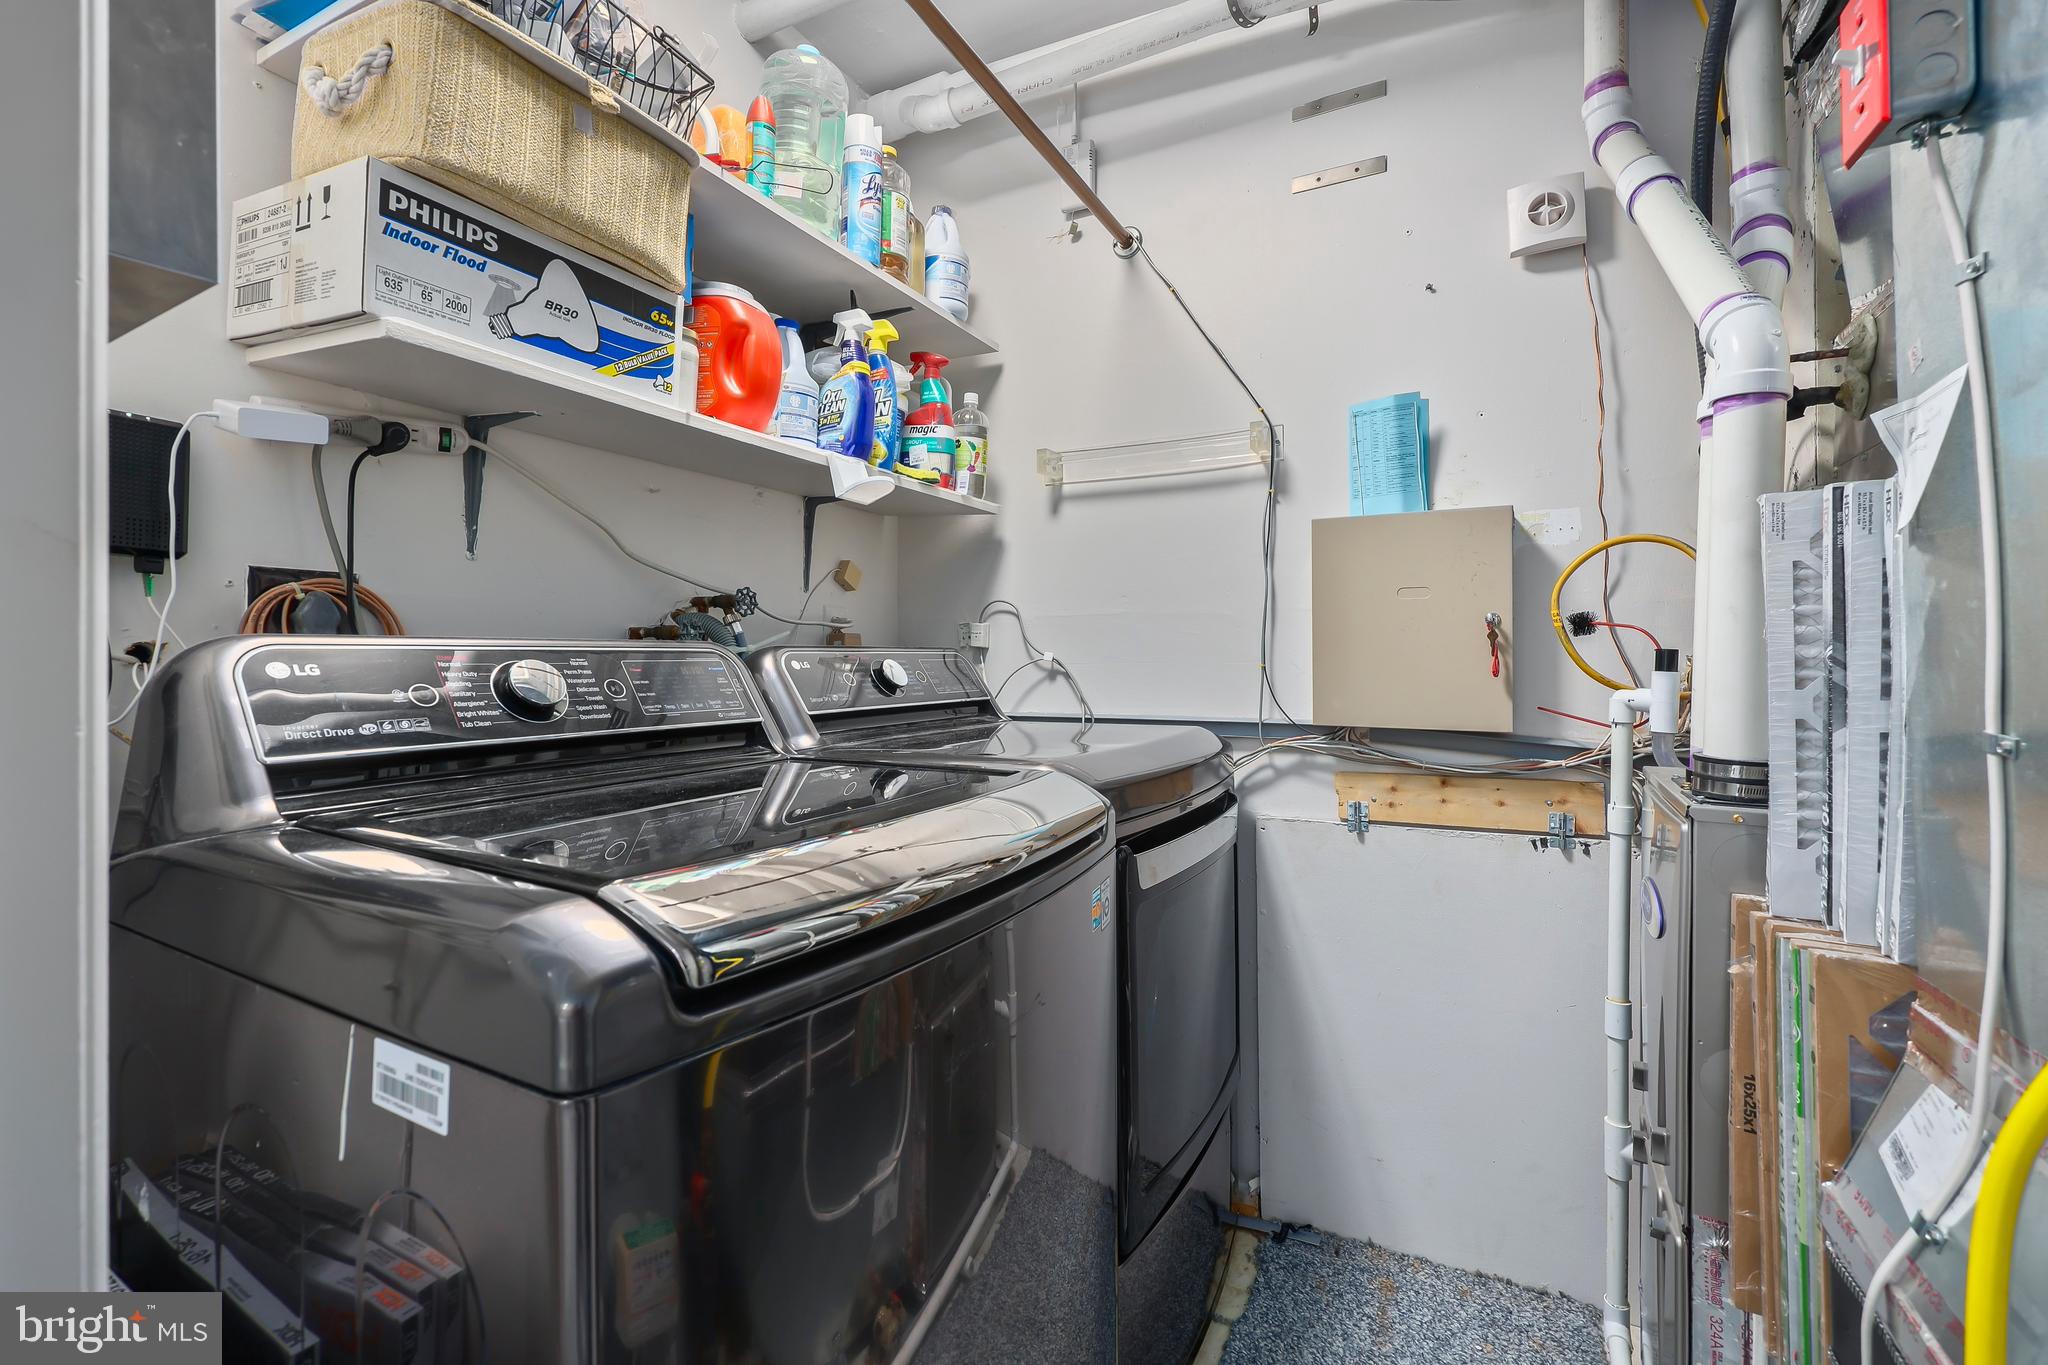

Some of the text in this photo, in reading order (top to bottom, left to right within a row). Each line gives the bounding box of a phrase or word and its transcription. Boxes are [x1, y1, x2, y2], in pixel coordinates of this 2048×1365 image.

[241, 213, 260, 226] PHILIPS
[388, 189, 499, 252] PHILIPS
[382, 221, 488, 273] Indoor Flood
[384, 277, 403, 291] 635
[420, 290, 433, 302] 65
[445, 298, 468, 314] 2000
[544, 299, 579, 320] BR30
[623, 316, 675, 340] INDOOR BR30 FLOOD
[614, 362, 624, 373] 12
[663, 382, 673, 393] 12
[822, 388, 842, 403] OXI
[909, 425, 938, 436] magic
[293, 663, 321, 676] LG
[800, 661, 810, 669] LG
[284, 727, 355, 740] Direct Drive
[1743, 1074, 1758, 1135] 16x25x1
[1709, 1315, 1724, 1350] 324A
